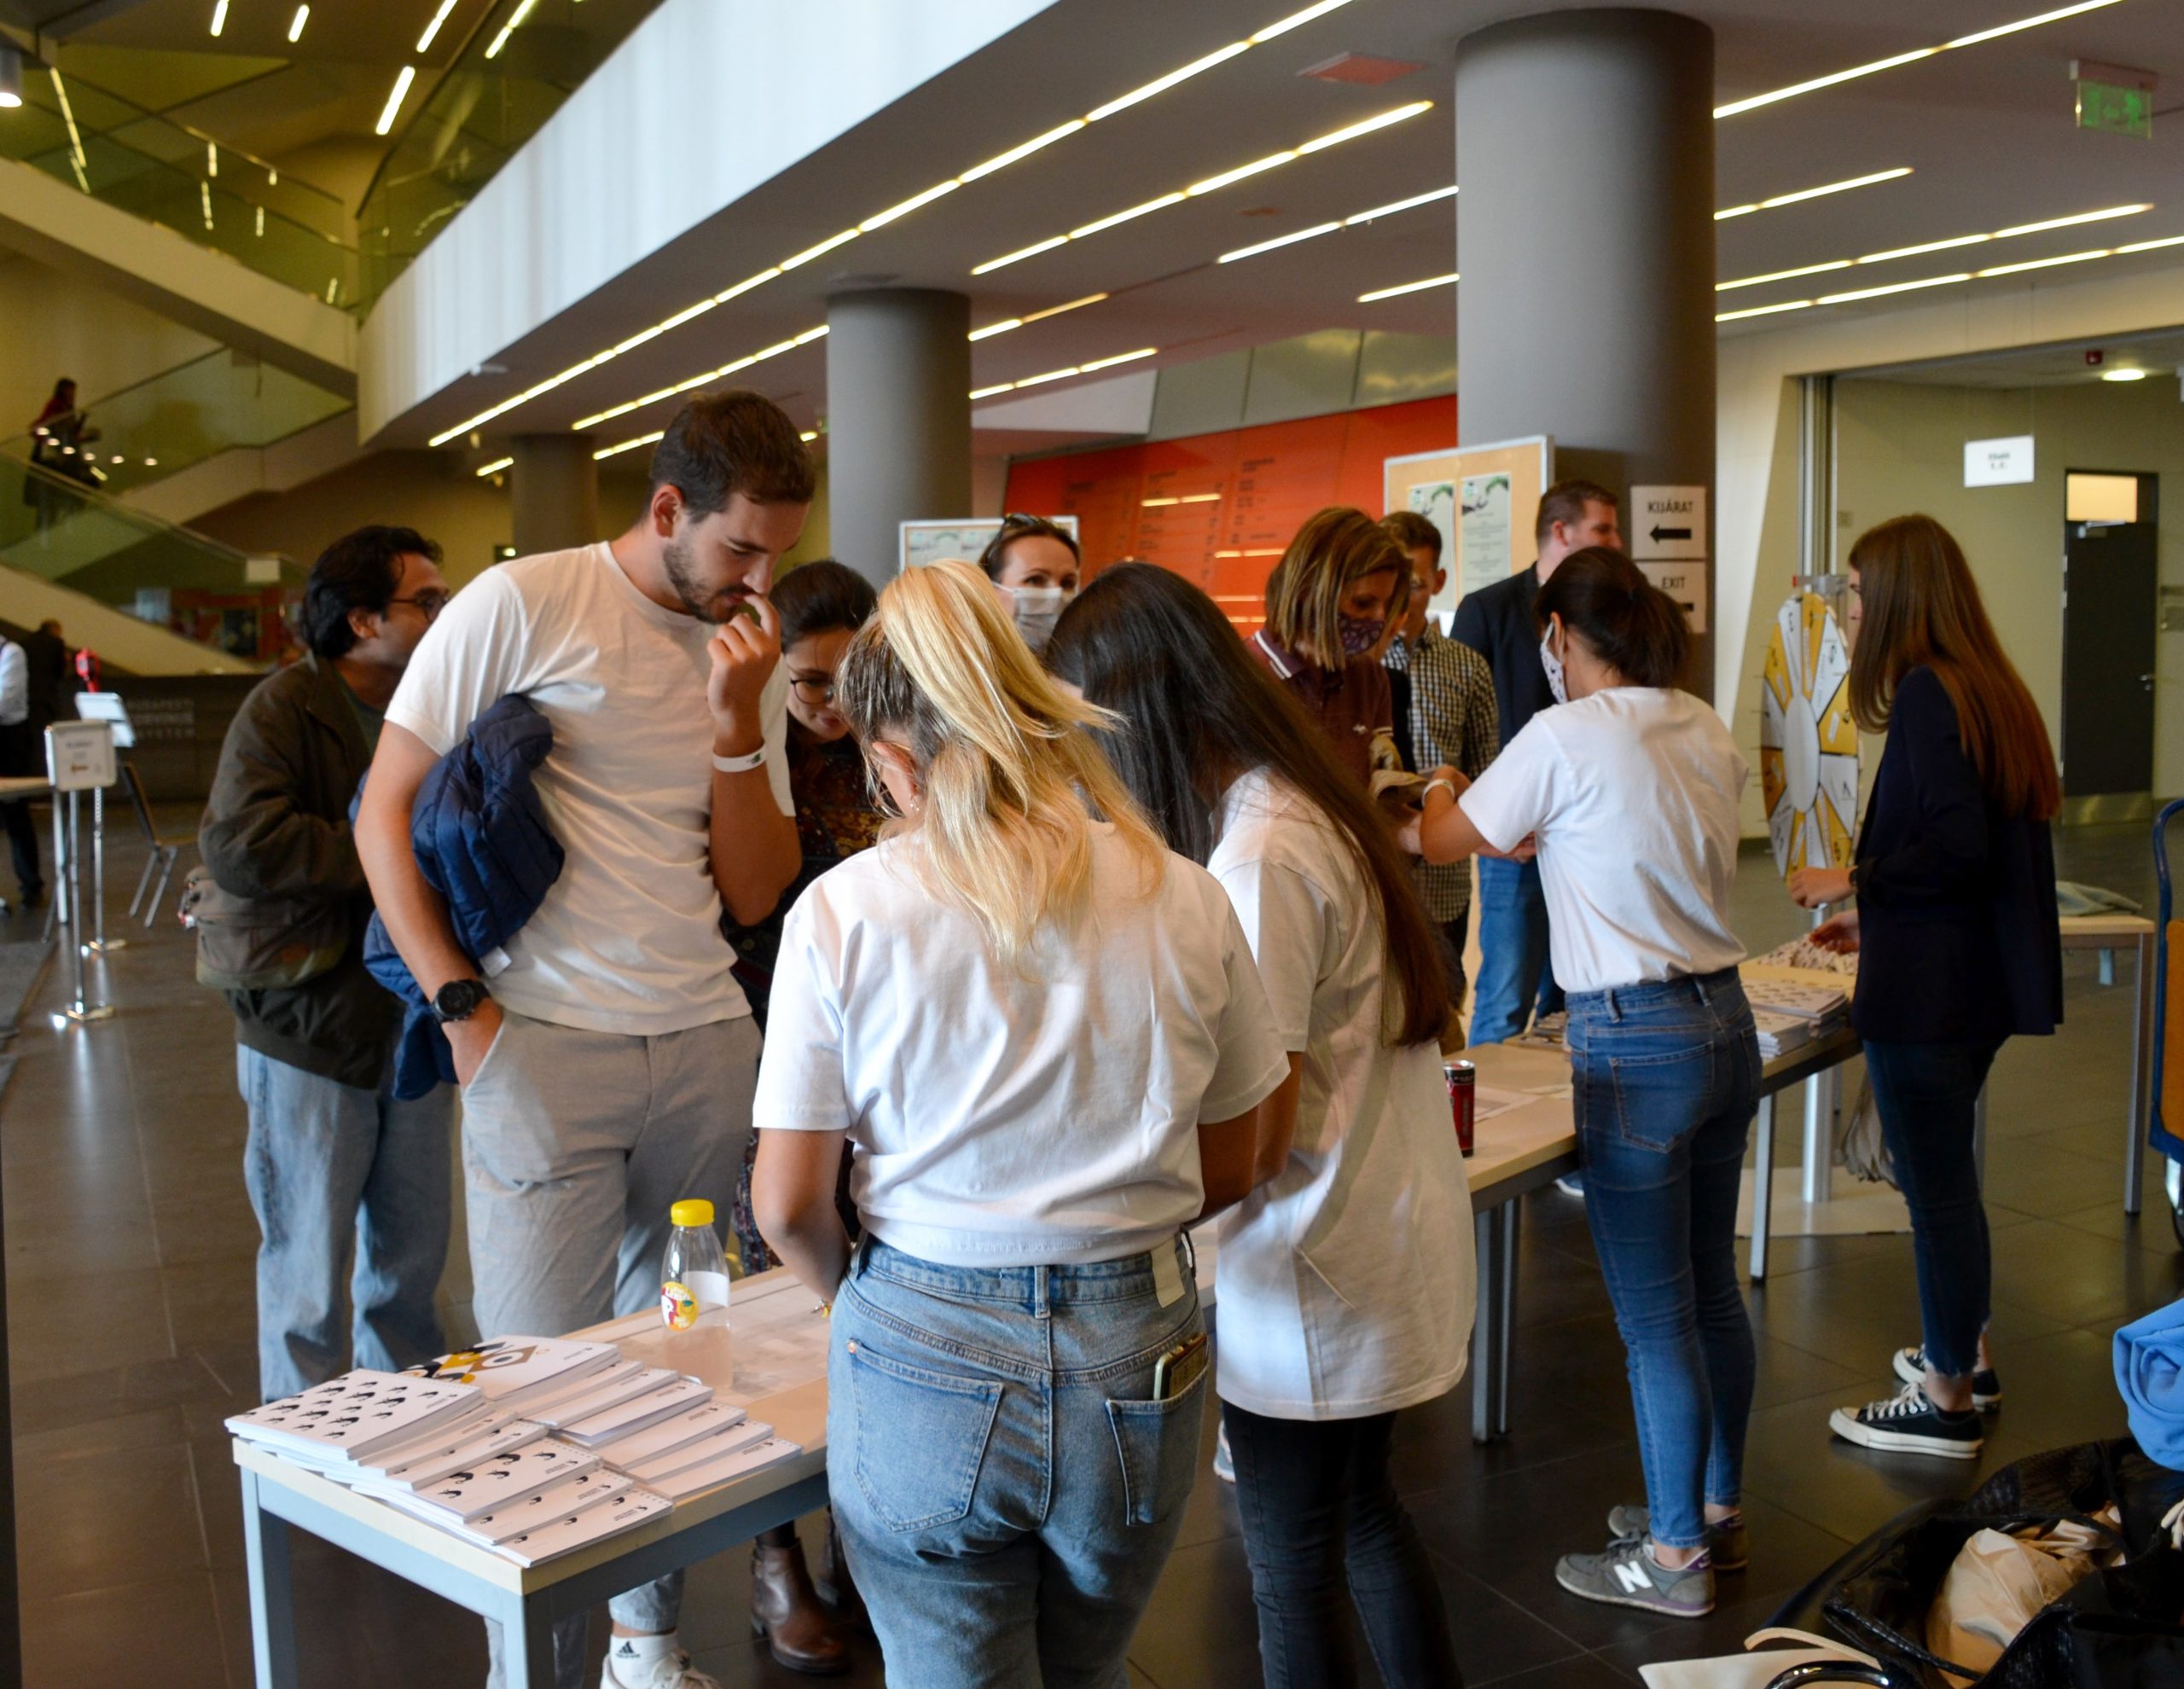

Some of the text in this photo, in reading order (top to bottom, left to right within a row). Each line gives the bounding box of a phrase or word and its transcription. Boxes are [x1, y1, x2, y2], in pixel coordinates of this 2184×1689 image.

[1647, 499, 1693, 514] KIJÁRAT
[1663, 577, 1686, 589] EXIT
[1613, 1560, 1653, 1593] N
